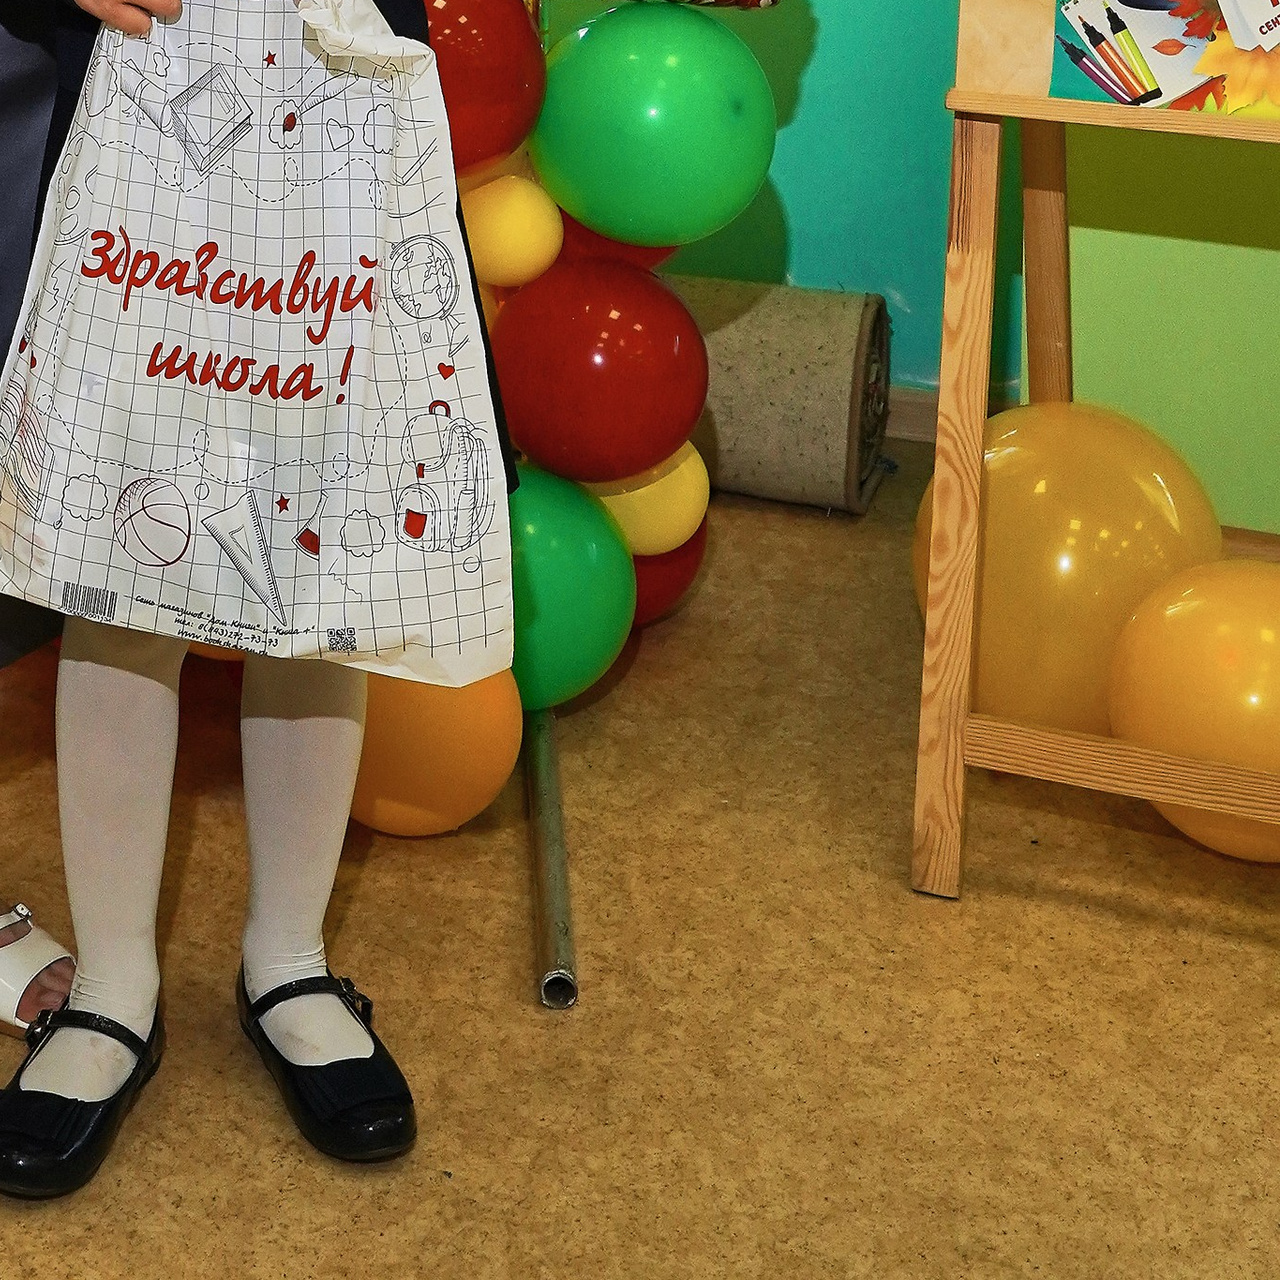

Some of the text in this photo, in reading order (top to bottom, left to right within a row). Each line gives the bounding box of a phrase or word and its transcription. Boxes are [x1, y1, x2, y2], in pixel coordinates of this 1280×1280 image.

[1259, 14, 1280, 35] СЕН
[81, 225, 379, 345] Здравствуй
[146, 340, 325, 403] школа
